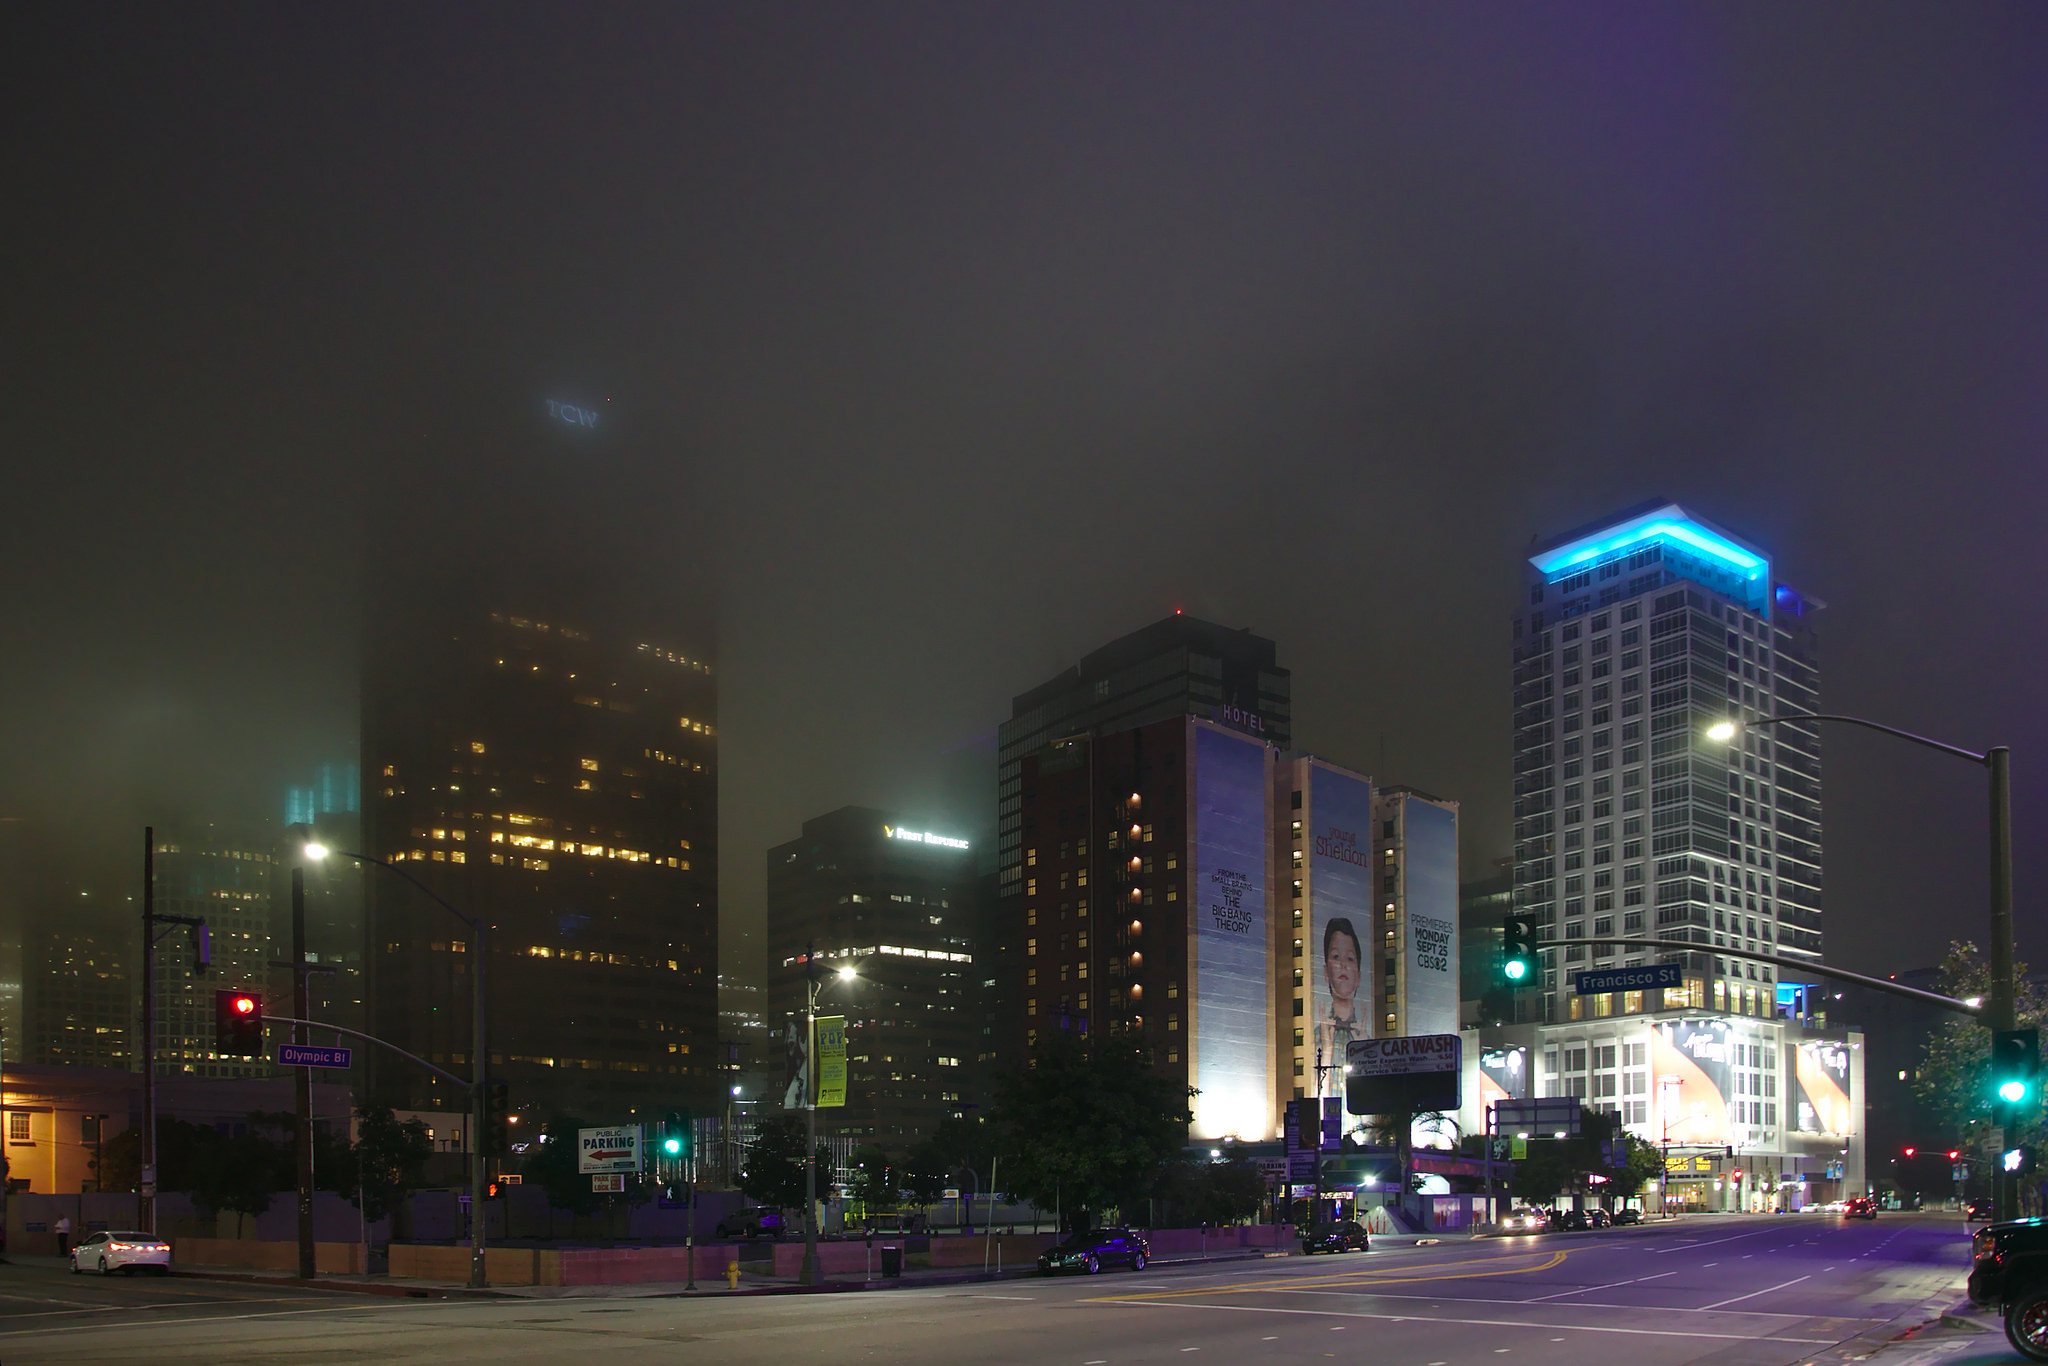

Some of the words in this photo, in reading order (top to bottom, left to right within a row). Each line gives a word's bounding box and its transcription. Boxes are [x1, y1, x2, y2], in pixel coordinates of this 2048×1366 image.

[546, 399, 597, 429] TCW
[1223, 703, 1265, 732] HOTEL
[1211, 875, 1231, 886] SMALL
[1231, 880, 1252, 891] BRAINS
[1217, 868, 1235, 879] FROM
[1235, 872, 1246, 881] THE
[1221, 886, 1242, 897] BEHIND
[1224, 895, 1240, 908] THE
[1212, 904, 1226, 918] BIG
[1227, 908, 1252, 923] BANG
[1215, 917, 1250, 934] THEORY
[1411, 913, 1453, 934] PREMIERES
[1415, 927, 1450, 945] MONDAY
[1416, 940, 1437, 954] SEPT
[1438, 945, 1448, 957] 25
[1582, 973, 1653, 989] Francisco
[1660, 969, 1675, 982] St
[820, 1031, 843, 1045] POP
[1381, 1040, 1410, 1056] CAR
[1412, 1037, 1453, 1054] WASH
[285, 1049, 330, 1063] Olympic
[334, 1052, 345, 1063] Bl
[583, 1136, 635, 1149] PARKING
